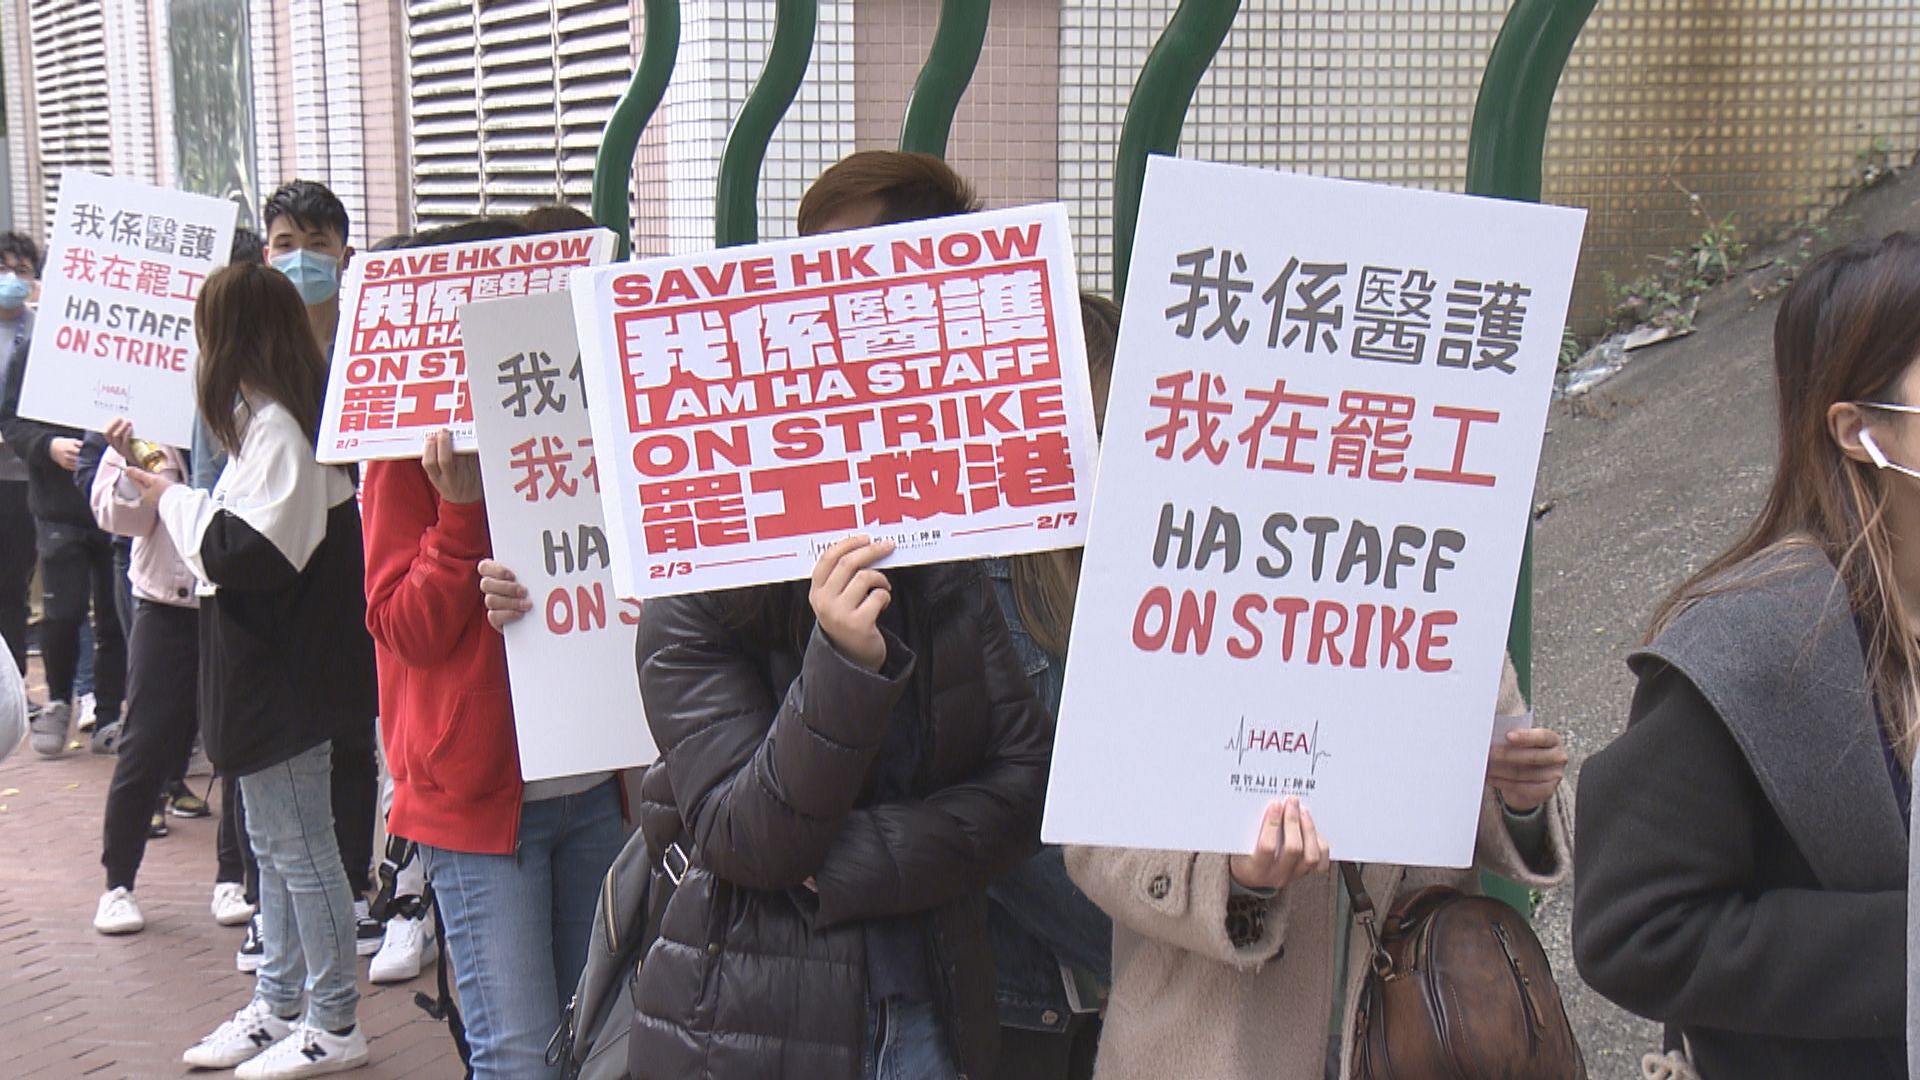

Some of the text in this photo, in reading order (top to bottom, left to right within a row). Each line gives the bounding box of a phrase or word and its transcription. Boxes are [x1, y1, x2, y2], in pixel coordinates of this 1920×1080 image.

[70, 203, 217, 261] 我係醫護
[364, 236, 594, 279] SAVE HK NOW
[62, 247, 207, 301] 我在罷工
[612, 223, 1042, 307] SAVE HK NOW
[65, 296, 192, 341] HA STAFF
[625, 269, 1049, 390] 我係醫護
[1165, 247, 1531, 374] 我係醫護
[56, 326, 188, 372] ON STRIKE
[354, 324, 463, 352] I AM HA
[346, 356, 408, 384] ON
[635, 343, 1050, 425] I AM HA STAFF
[632, 385, 1067, 478] ON STRIKE
[1145, 370, 1500, 487] 我在罷工
[638, 431, 1076, 555] 罷工救港
[1037, 512, 1078, 530] 2/7
[1152, 502, 1466, 592] HA STAFF
[543, 524, 610, 576] HA
[649, 561, 693, 579] 2/3
[546, 582, 606, 635] ON
[1132, 585, 1459, 673] ON STRIKE
[1249, 729, 1309, 755] HAEA
